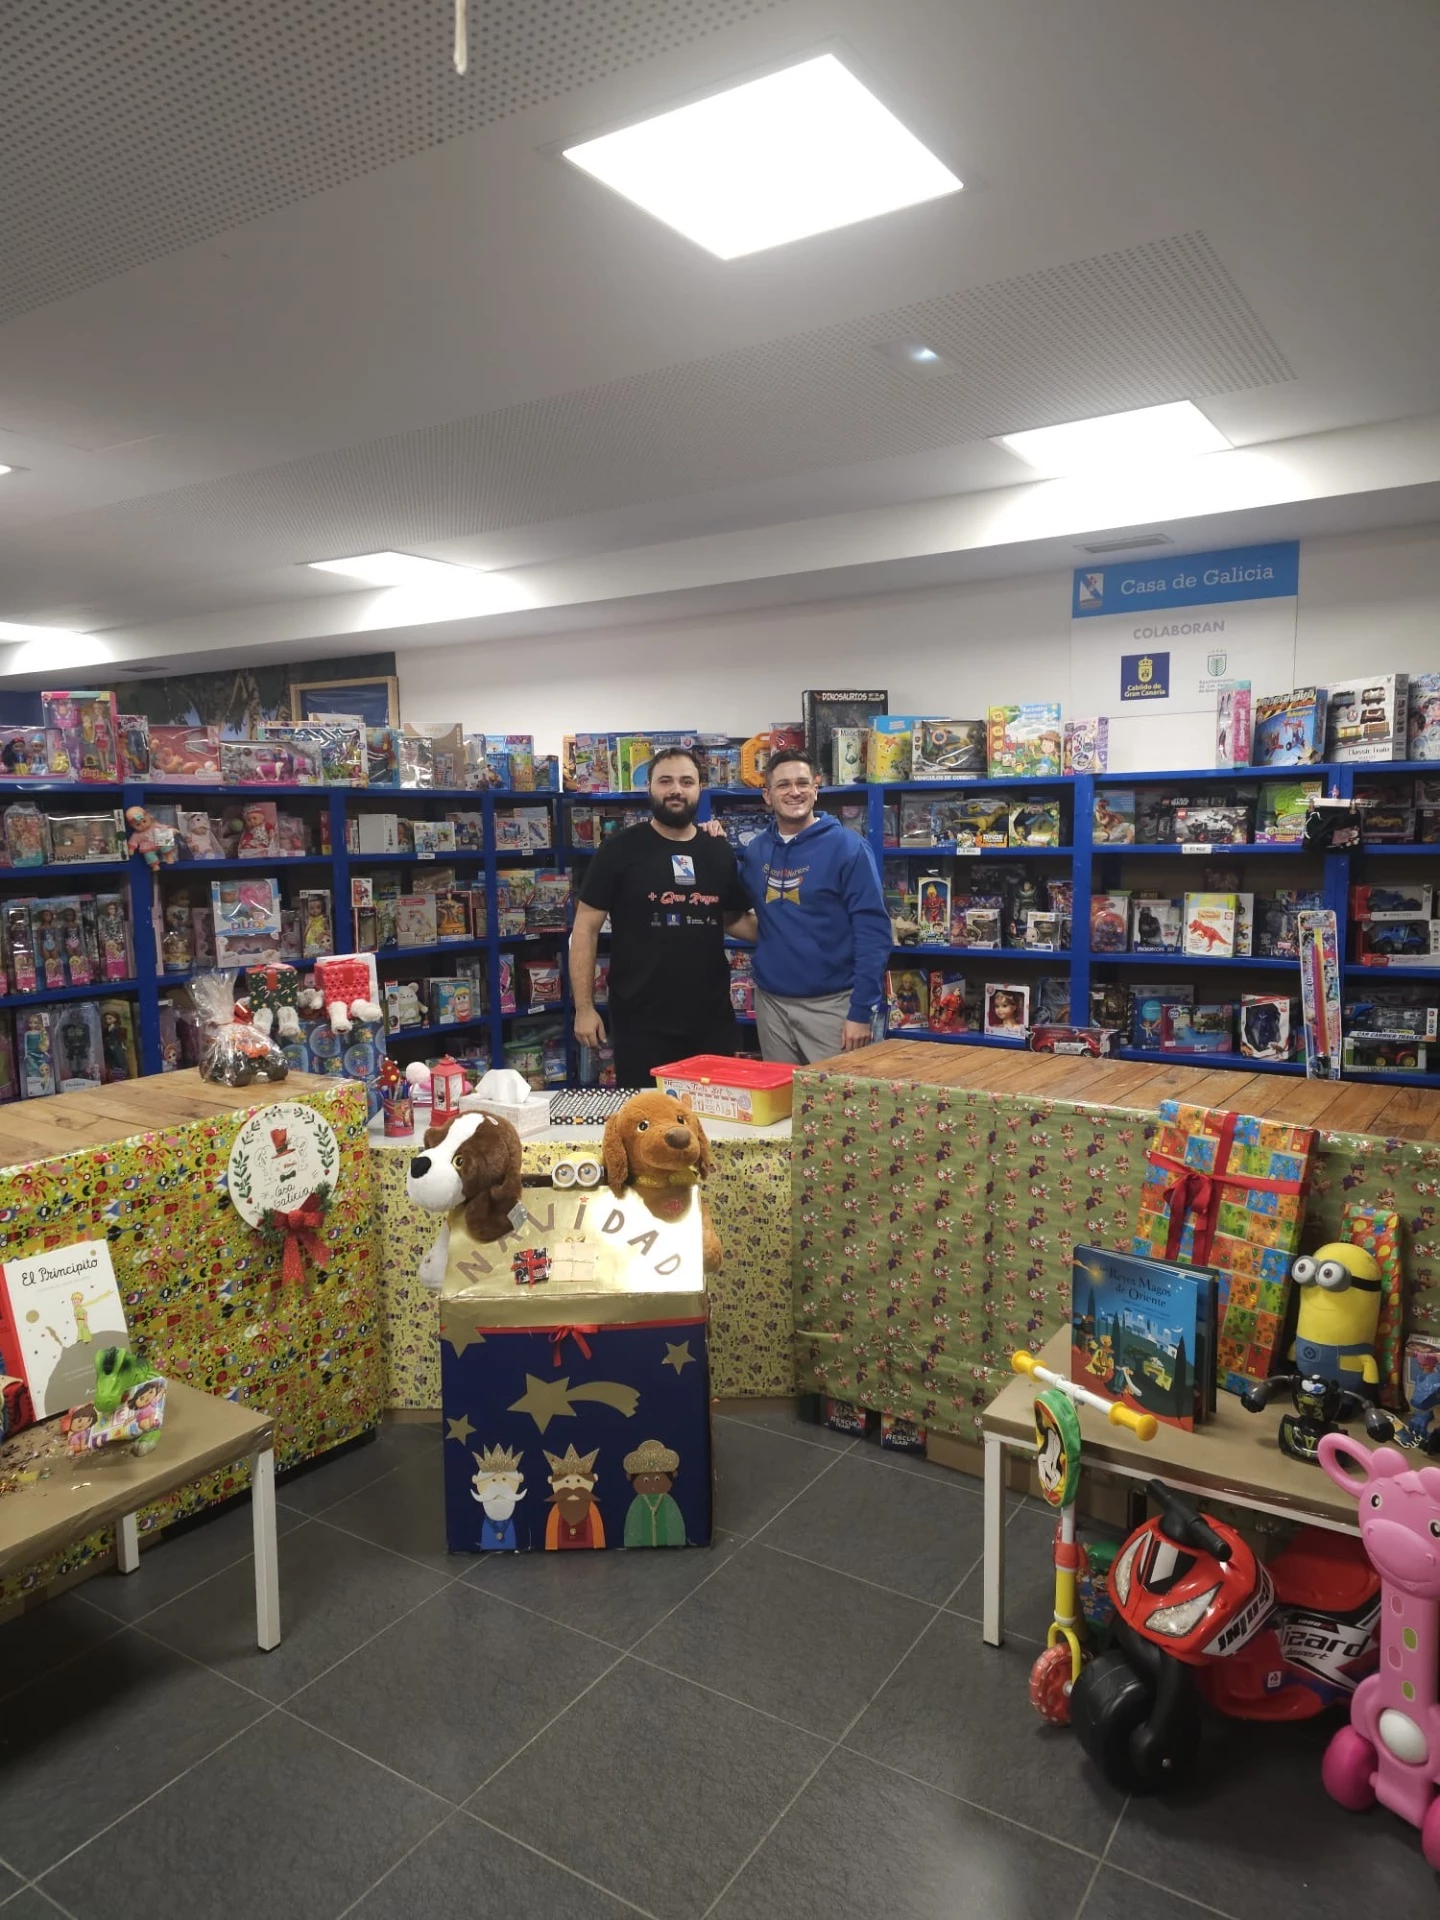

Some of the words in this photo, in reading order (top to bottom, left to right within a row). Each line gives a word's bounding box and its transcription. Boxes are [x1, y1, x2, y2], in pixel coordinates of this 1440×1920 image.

[1120, 579, 1167, 595] Casa
[1172, 573, 1198, 589] de
[1203, 564, 1275, 586] Galicia
[1133, 620, 1226, 640] COLABORAN
[822, 692, 868, 701] DINOSAURIOS
[22, 1271, 37, 1287] El
[38, 1258, 98, 1283] Principito
[1109, 1266, 1136, 1286] Reyes
[1139, 1277, 1172, 1298] Magos
[1115, 1283, 1126, 1294] de
[1128, 1288, 1167, 1308] Oriente
